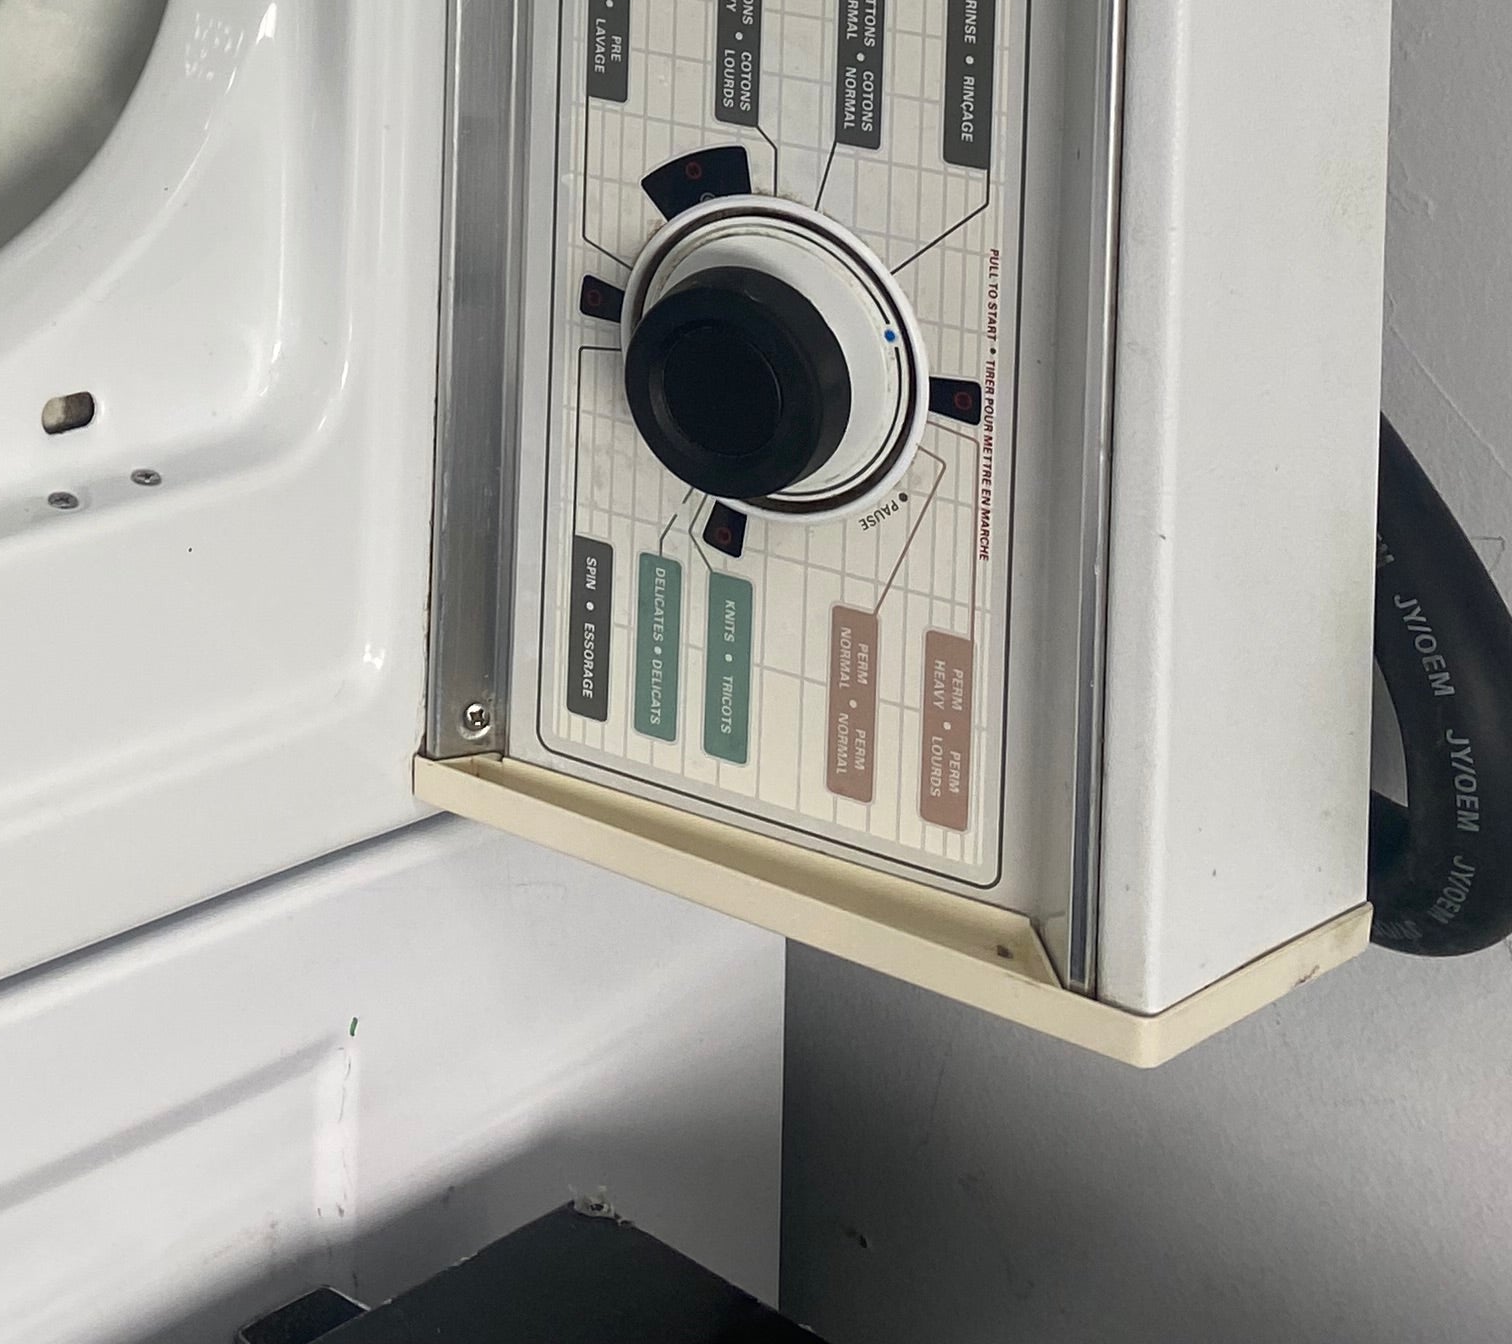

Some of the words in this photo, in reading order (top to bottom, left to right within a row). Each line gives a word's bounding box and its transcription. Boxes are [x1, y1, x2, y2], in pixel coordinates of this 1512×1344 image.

[593, 18, 607, 73] LAVAGE
[963, 0, 977, 44] RINSE
[610, 35, 623, 62] PRE
[723, 49, 736, 108] LOURDS
[739, 52, 752, 111] COTONS
[843, 67, 857, 130] NORMAL
[861, 71, 874, 132] COTONS
[960, 76, 975, 142] RINÇAGE
[989, 249, 1000, 280] PULL
[988, 283, 998, 299] TO
[987, 302, 998, 341] START
[985, 360, 996, 395] TIRER
[983, 398, 995, 432] POUR
[981, 435, 993, 485] METTRE
[859, 499, 899, 531] PAUSE
[981, 488, 992, 506] EN
[979, 508, 991, 561] MARCHE
[586, 557, 597, 590] SPIN
[653, 568, 666, 641] DELICATES
[724, 600, 735, 642] KNITS
[582, 623, 595, 698] ESSORAGE
[838, 627, 852, 689] NORMAL
[856, 643, 869, 685] PERM
[1392, 594, 1455, 697] JY/OEM
[650, 659, 662, 725] DELICATS
[721, 676, 733, 734] TRICOTS
[932, 659, 946, 710] HEAVY
[950, 669, 963, 710] PERM
[835, 712, 850, 775] NORMAL
[853, 728, 866, 770] PERM
[929, 735, 943, 797] LOURDS
[948, 750, 961, 793] PERM
[1444, 728, 1481, 833] JY/OEM
[1427, 854, 1477, 925] JY/OEM
